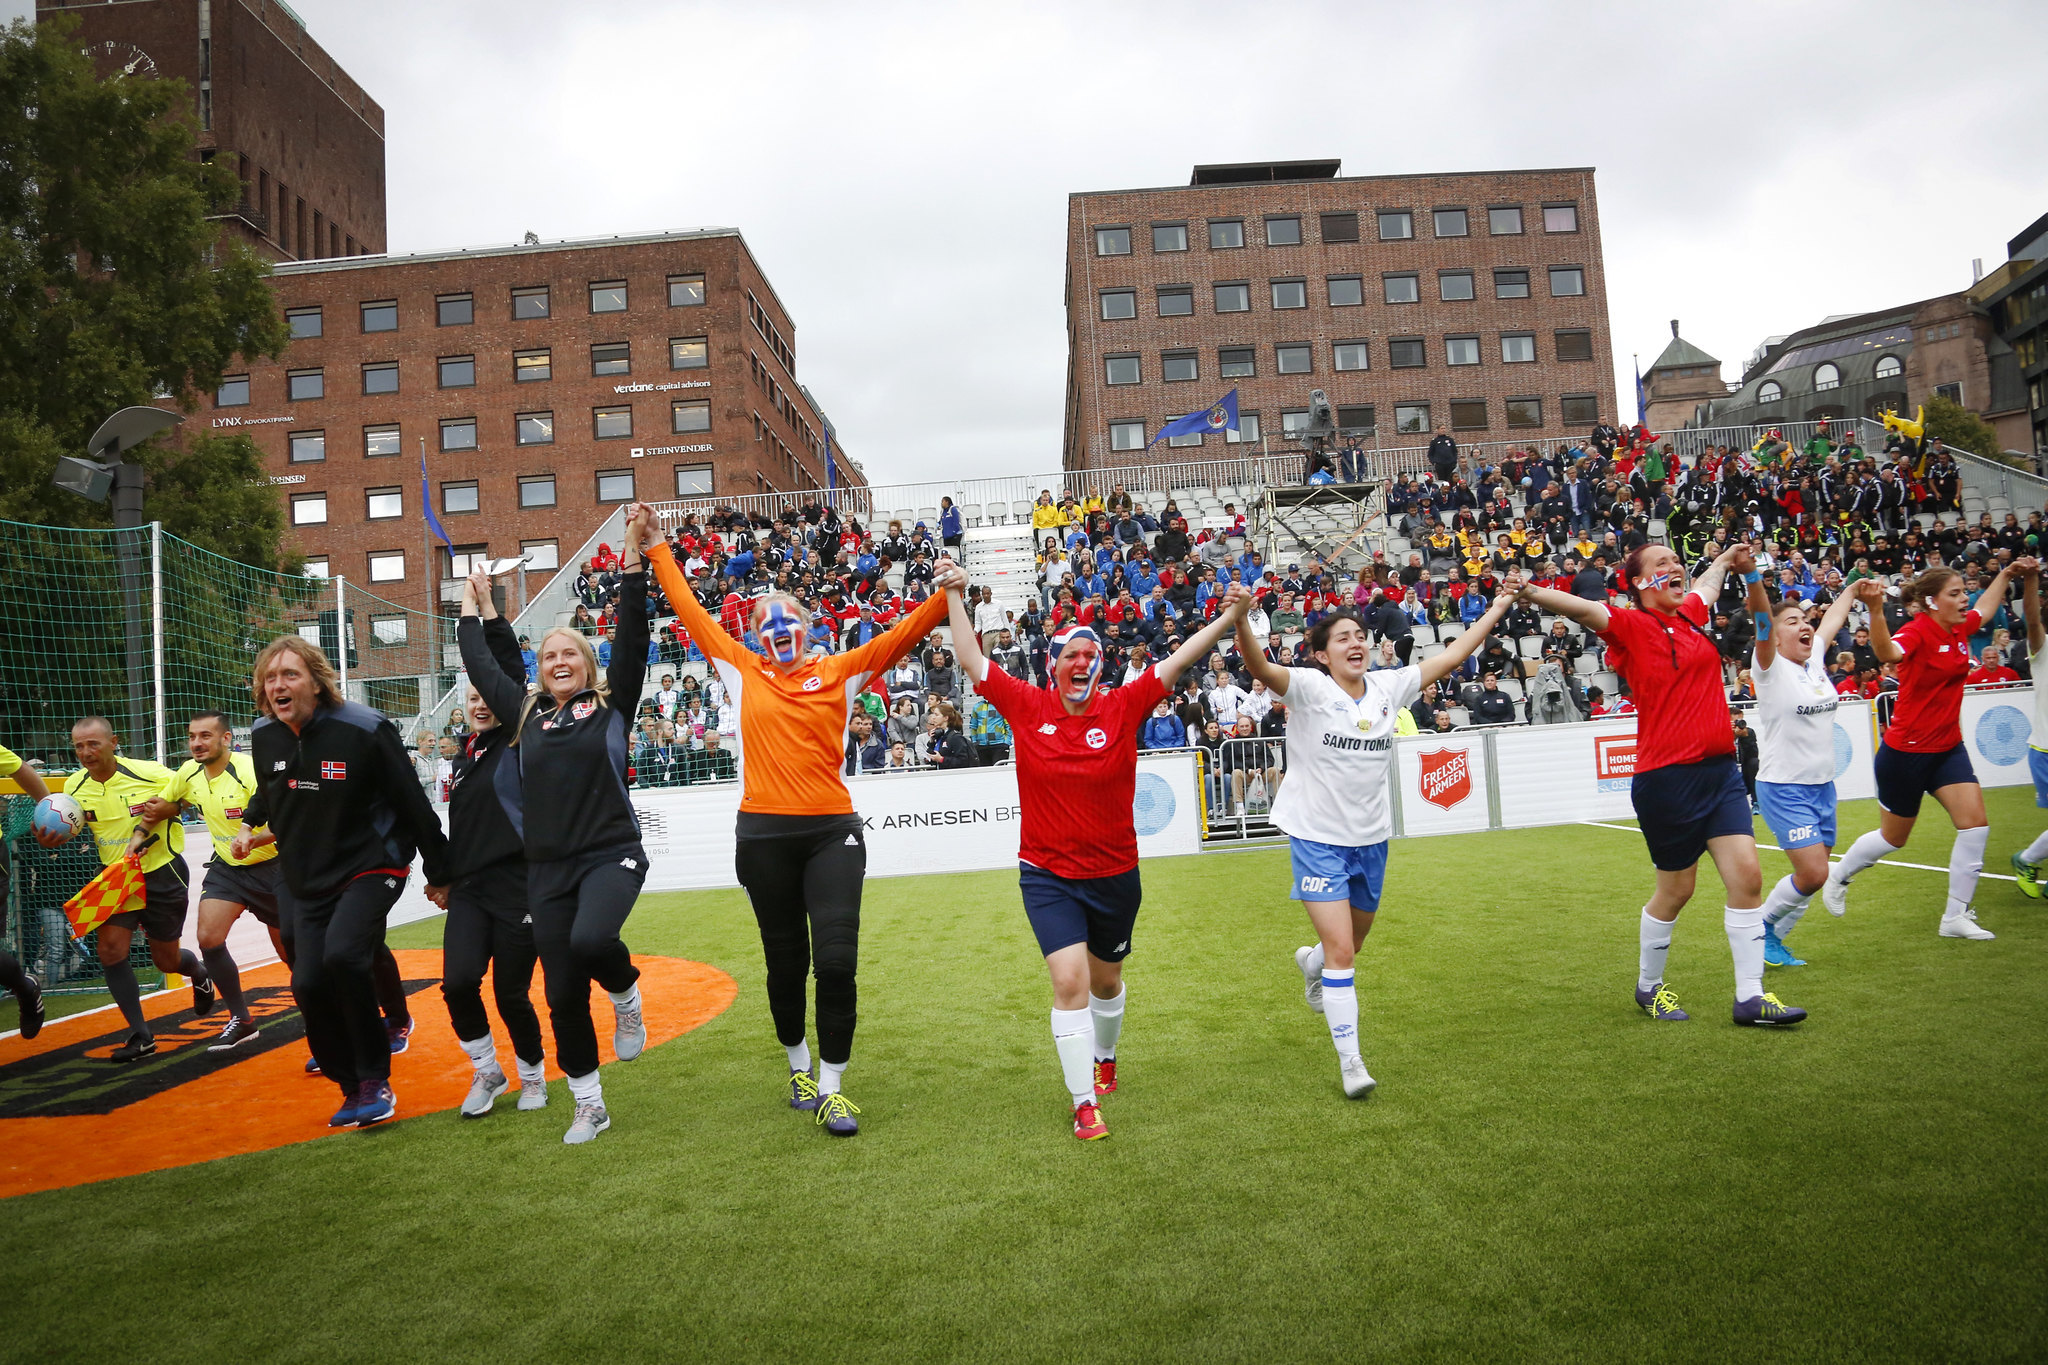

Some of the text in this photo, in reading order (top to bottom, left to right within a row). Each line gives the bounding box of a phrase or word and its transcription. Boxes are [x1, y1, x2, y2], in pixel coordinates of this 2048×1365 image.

[613, 380, 711, 394] verdane capital advisors
[212, 417, 242, 428] LYNX
[646, 444, 714, 456] STEINVENDER
[1322, 732, 1361, 751] SANTO
[1423, 754, 1466, 790] FRELSES
[1428, 767, 1466, 800] ARMEEN
[882, 808, 988, 830] ARNESEN
[1789, 825, 1817, 842] CDF.
[1301, 876, 1333, 893] CDF.
